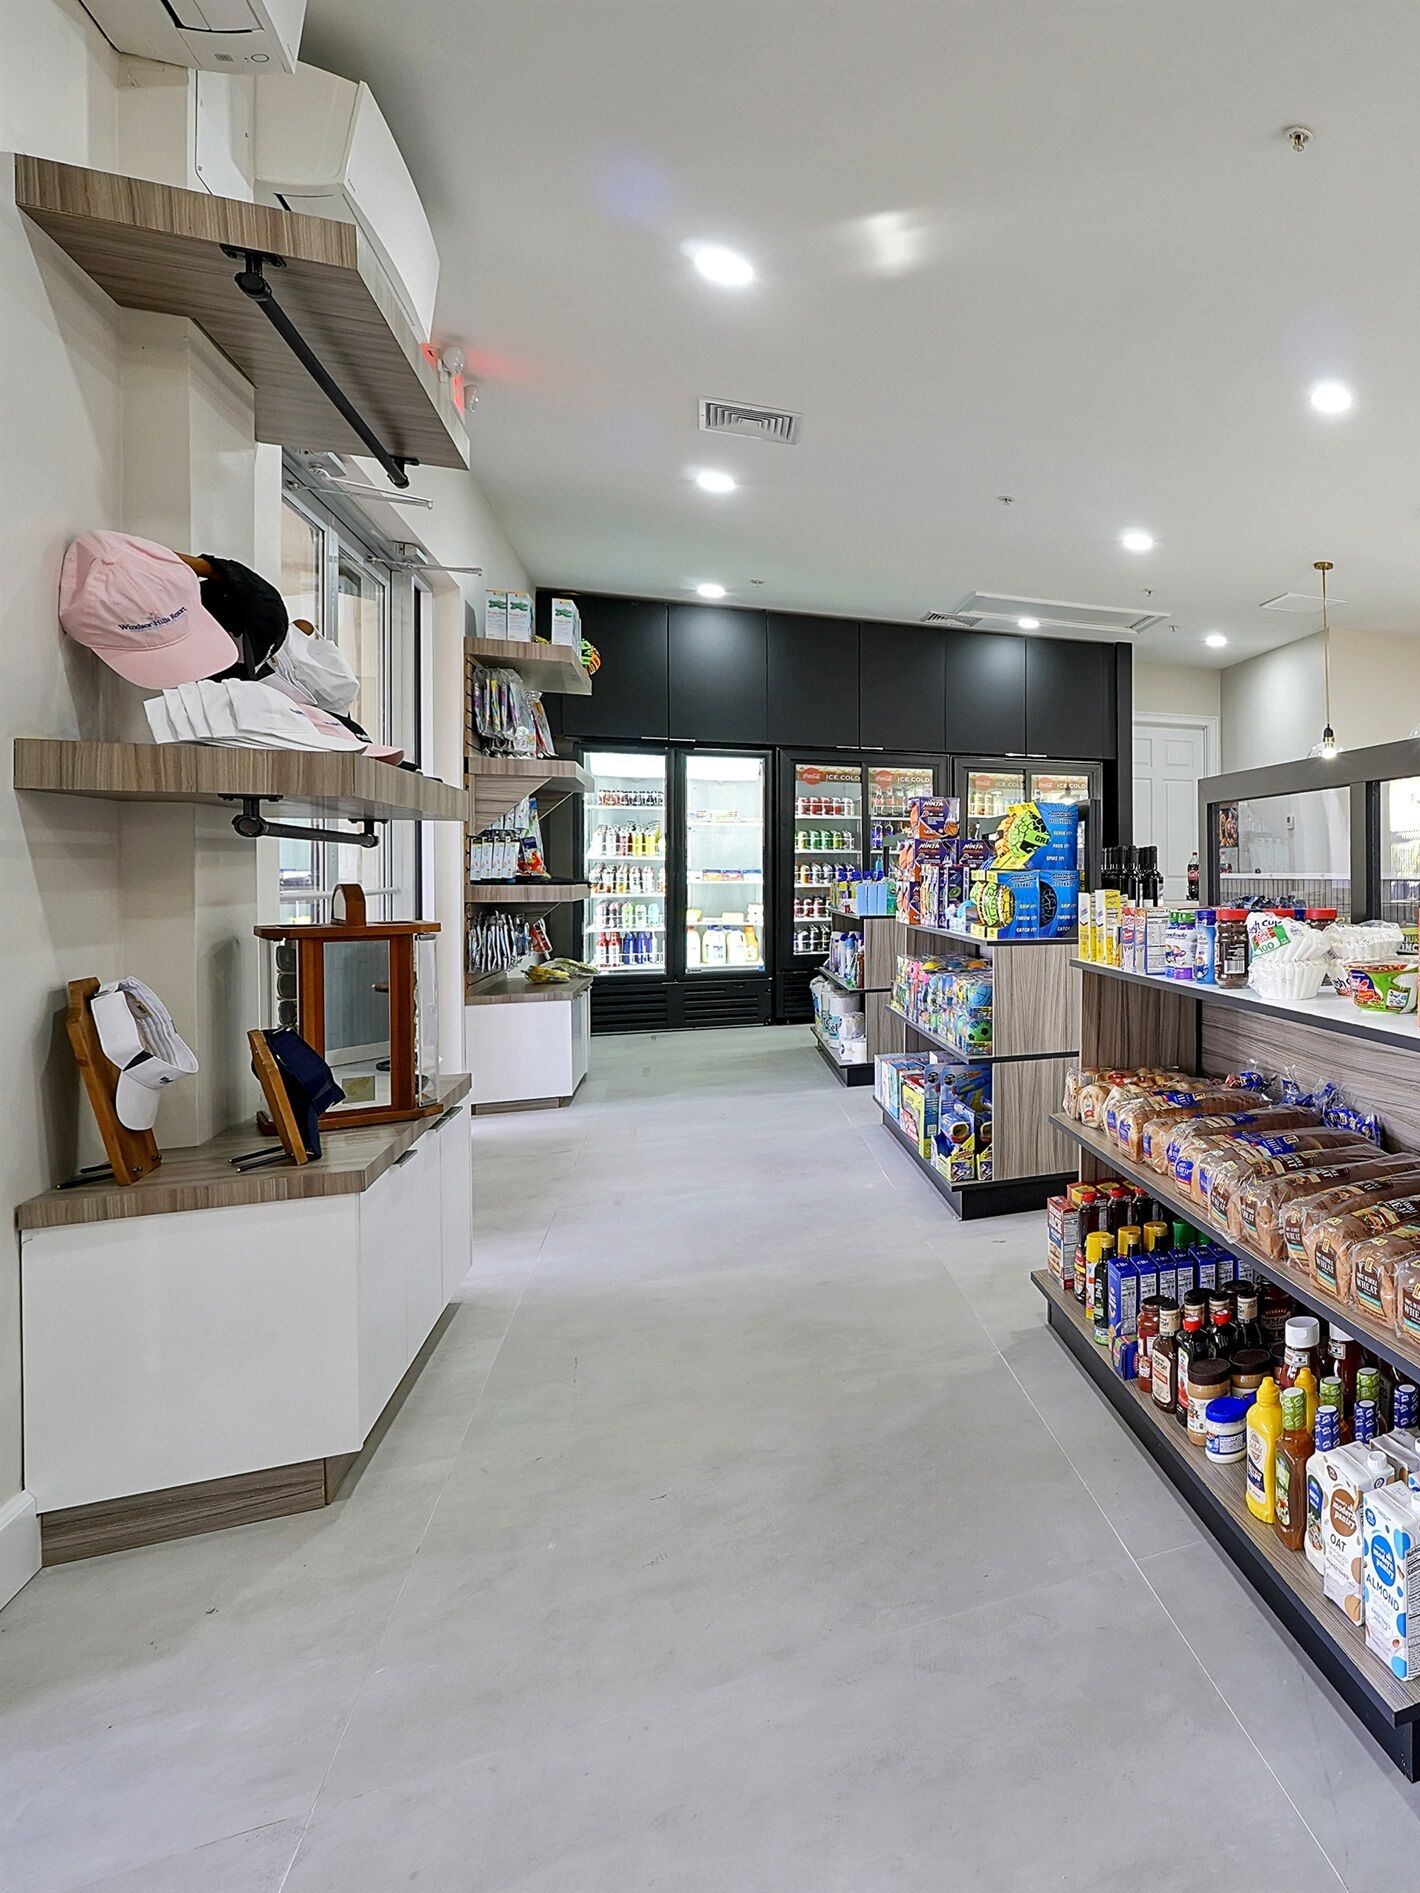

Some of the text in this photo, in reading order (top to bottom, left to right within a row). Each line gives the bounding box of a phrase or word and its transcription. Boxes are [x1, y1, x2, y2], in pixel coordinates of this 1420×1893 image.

[118, 622, 152, 630] Windsor
[152, 616, 170, 626] Hills
[1258, 941, 1275, 953] 100
[1316, 1256, 1334, 1274] WHEAT
[1357, 1277, 1378, 1295] WHEAT
[1334, 1511, 1356, 1530] pantry
[1330, 1533, 1347, 1552] OAT
[1366, 1574, 1400, 1611] ALMOND
